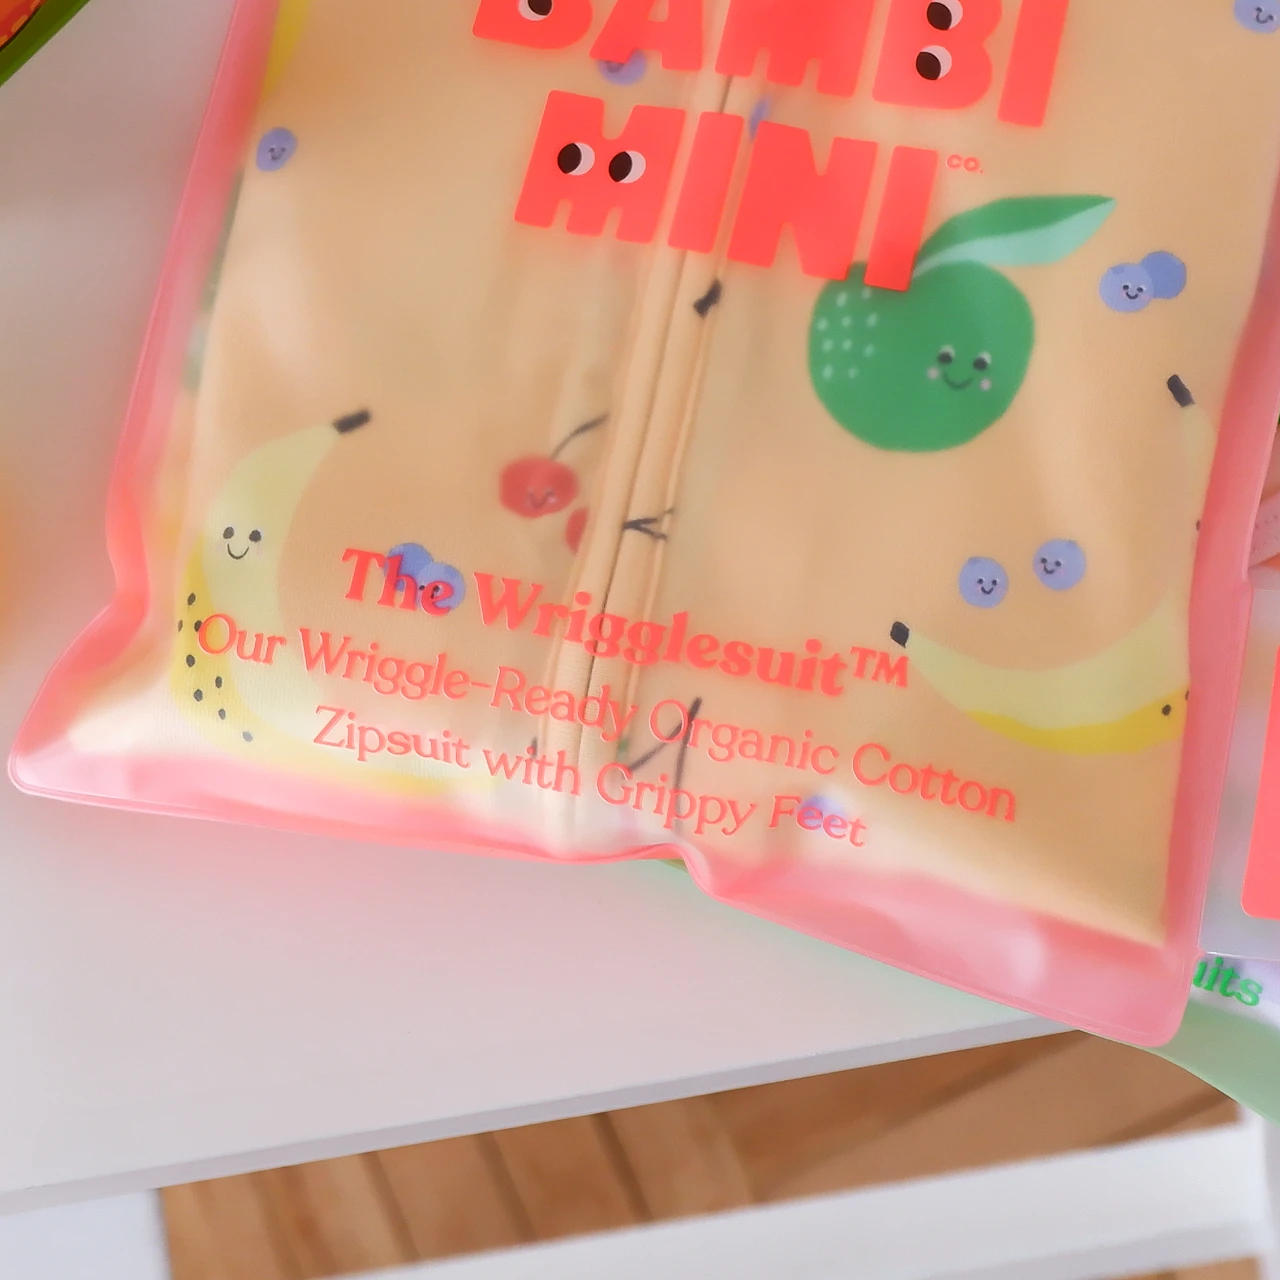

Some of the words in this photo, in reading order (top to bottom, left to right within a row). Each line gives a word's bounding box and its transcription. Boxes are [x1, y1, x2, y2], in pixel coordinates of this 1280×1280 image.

[514, 89, 939, 292] MINI
[341, 547, 455, 617] The
[196, 613, 287, 665] Our
[298, 626, 639, 742] Wriggle-Ready
[648, 697, 841, 776] Organic
[851, 742, 1017, 824] Cotton
[313, 704, 472, 769] Zipsuit
[481, 738, 582, 797] with
[596, 761, 759, 837] Grippy
[768, 795, 870, 848] Feet
